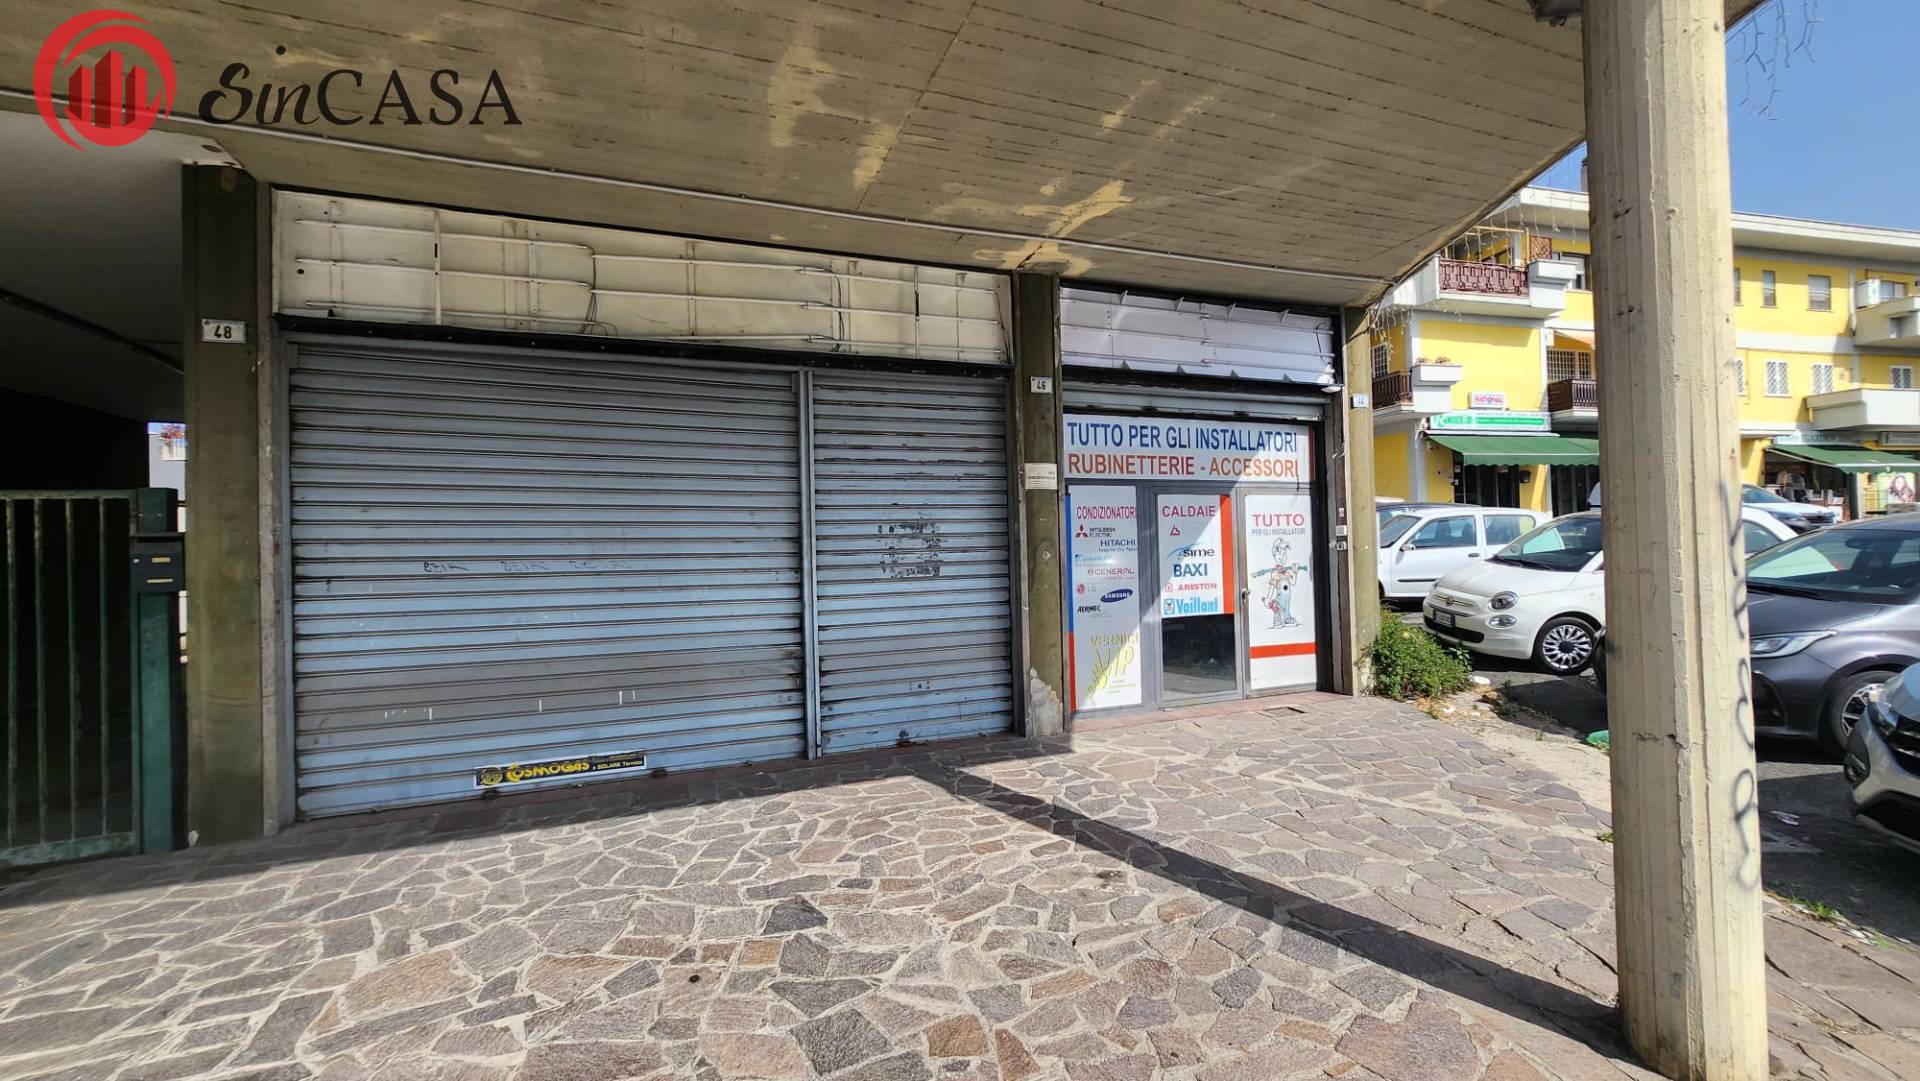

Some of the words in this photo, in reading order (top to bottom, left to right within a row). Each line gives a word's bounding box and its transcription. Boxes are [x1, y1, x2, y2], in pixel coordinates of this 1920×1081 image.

[214, 325, 232, 339] 48
[1037, 380, 1047, 391] 46
[1067, 422, 1123, 447] TUTTO
[1129, 424, 1161, 448] PER
[1166, 426, 1191, 449] GLI
[1196, 427, 1297, 453] INSTALLATORI
[1068, 453, 1195, 475] RUBINETTERIE
[1209, 457, 1299, 477] ACCESSORI
[1162, 505, 1216, 518] CALDAIE
[1251, 513, 1305, 527] TUTTO
[1100, 539, 1136, 547] HITACHI
[1184, 548, 1215, 557] sime
[1174, 564, 1208, 577] BAXI
[1178, 583, 1218, 591] ARISTON
[1077, 605, 1101, 613] AERMEC
[1177, 597, 1218, 613] Vaillant
